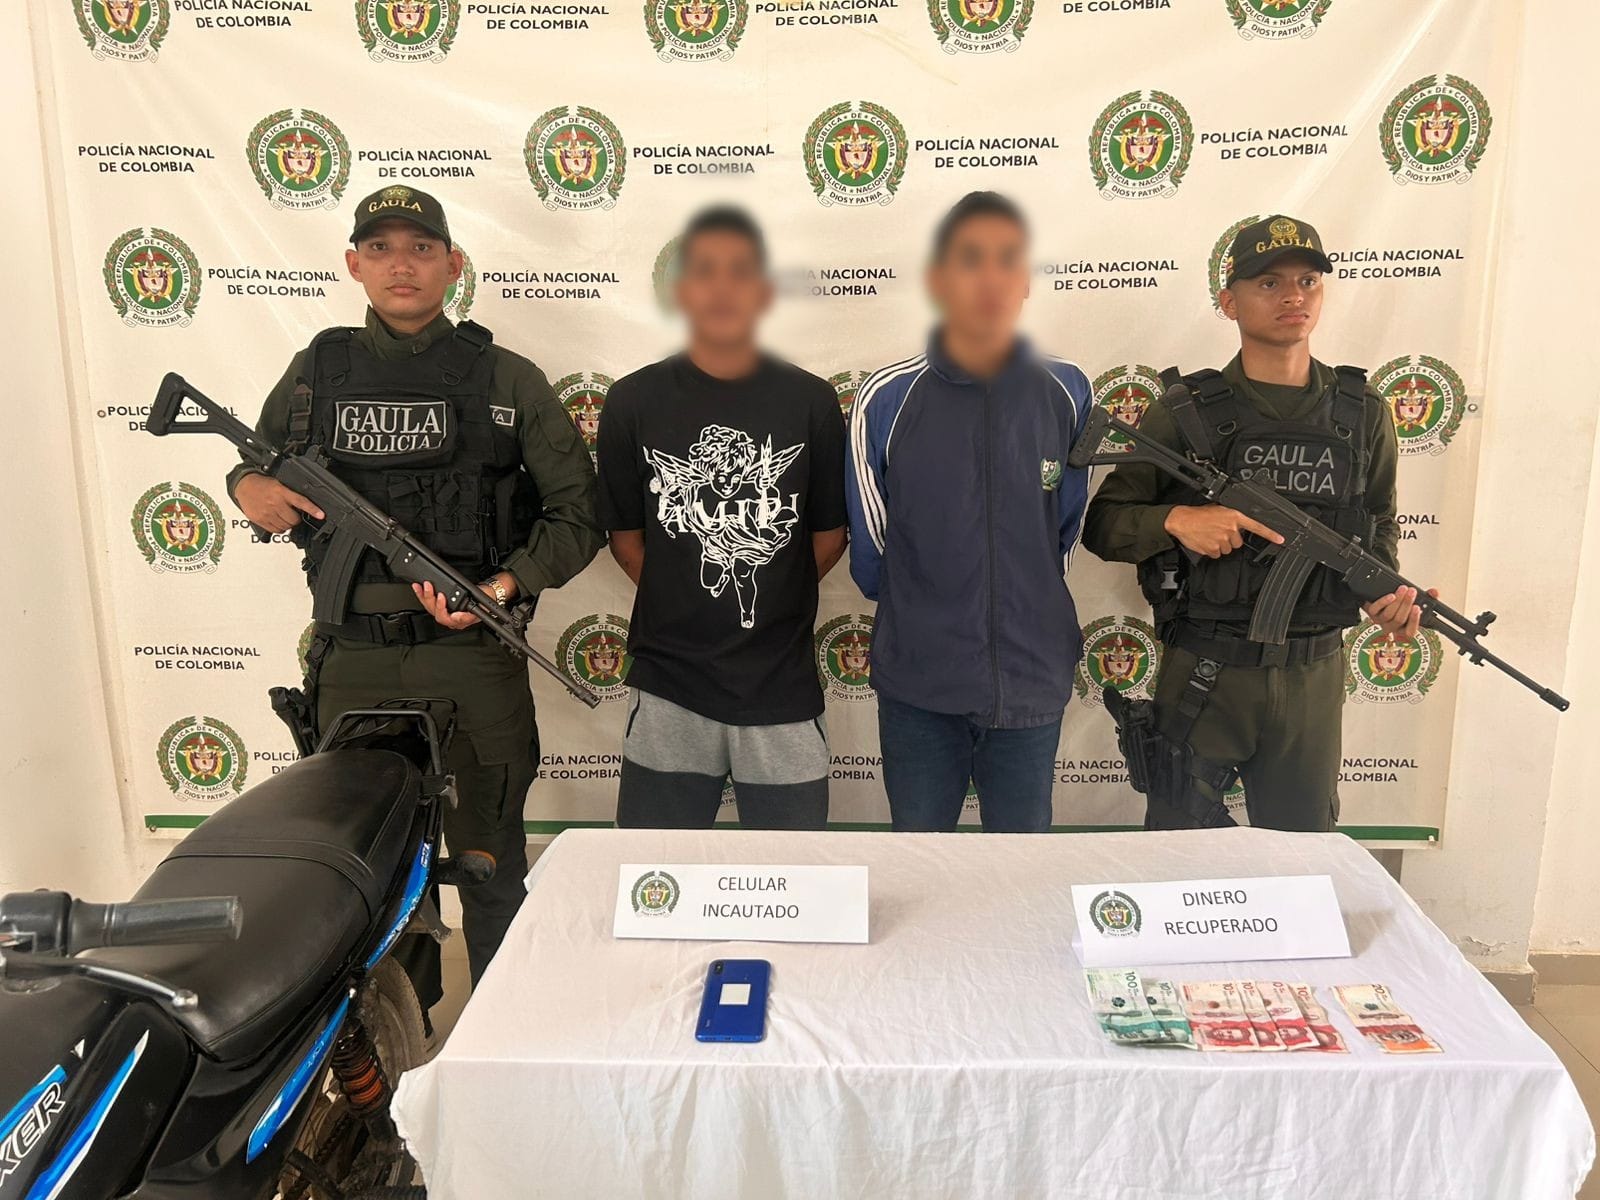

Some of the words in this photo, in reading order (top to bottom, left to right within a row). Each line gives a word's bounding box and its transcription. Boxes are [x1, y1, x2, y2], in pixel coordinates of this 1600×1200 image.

[232, 0, 312, 11] NACIONAL
[468, 3, 526, 14] POLICÍA
[531, 5, 609, 15] NACIONAL
[819, 0, 898, 10] NACIONAL
[1063, 2, 1083, 13] DE
[1087, 0, 1171, 12] COLOMBIA
[196, 17, 214, 28] DE
[216, 16, 291, 28] COLOMBIA
[487, 19, 505, 29] DE
[510, 19, 589, 29] COLOMBIA
[776, 16, 794, 26] DE
[799, 14, 878, 25] COLOMBIA
[1201, 128, 1263, 144] POLICÍA
[1268, 125, 1348, 140] NACIONAL
[916, 136, 975, 151] POLICÍA
[980, 137, 1059, 150] NACIONAL
[78, 143, 135, 156] POLICÍA
[138, 145, 215, 159] NACIONAL
[358, 148, 414, 161] POLICÍA
[417, 150, 492, 161] NACIONAL
[633, 144, 692, 158] POLICÍA
[696, 144, 774, 157] NACIONAL
[1221, 148, 1241, 160] DE
[1246, 143, 1327, 158] COLOMBIA
[99, 162, 117, 172] DE
[121, 161, 195, 172] COLOMBIA
[654, 164, 672, 174] DE
[677, 162, 755, 174] COLOMBIA
[935, 157, 954, 168] DE
[958, 155, 1038, 167] COLOMBIA
[379, 167, 397, 178] DE
[401, 167, 475, 177] COLOMBIA
[368, 200, 423, 213] GAULA
[1256, 238, 1313, 253] GAULA
[1328, 248, 1380, 264] OLICÍA
[1383, 249, 1464, 261] NACIONAL
[821, 268, 896, 279] NACIONAL
[1044, 260, 1094, 274] OLICÍA
[1098, 260, 1179, 273] NACIONAL
[1338, 268, 1358, 279] DE
[1361, 266, 1441, 278] COLOMBIA
[208, 266, 261, 279] POLICÍA
[266, 270, 340, 282] NACIONAL
[483, 270, 540, 283] POLICÍA
[544, 273, 620, 283] NACIONAL
[1054, 280, 1073, 290] DE
[1077, 277, 1158, 289] COLOMBIA
[227, 285, 244, 295] DE
[246, 285, 326, 297] COLOMBIA
[502, 288, 520, 298] DE
[524, 288, 601, 299] COLOMBIA
[812, 285, 877, 296] OLOMBIA
[340, 406, 442, 434] GAULA
[346, 433, 430, 452] POLICIA
[1244, 444, 1334, 469] GAULA
[1240, 468, 1335, 495] PLICIA
[1397, 514, 1440, 524] ONAL
[134, 646, 189, 656] POLICÍA
[192, 646, 260, 656] NACIONAL
[155, 660, 173, 669] DE
[176, 660, 245, 670] COLOMBIA
[568, 755, 621, 764] NACION
[830, 756, 883, 766] ACIONA
[1343, 758, 1418, 768] NACIONAL
[550, 769, 621, 779] COLOMBIA
[718, 877, 787, 891] CELULAR
[1183, 890, 1247, 907] DINERO
[703, 904, 799, 919] INCAUTADO
[1165, 918, 1278, 936] RECUPERADO
